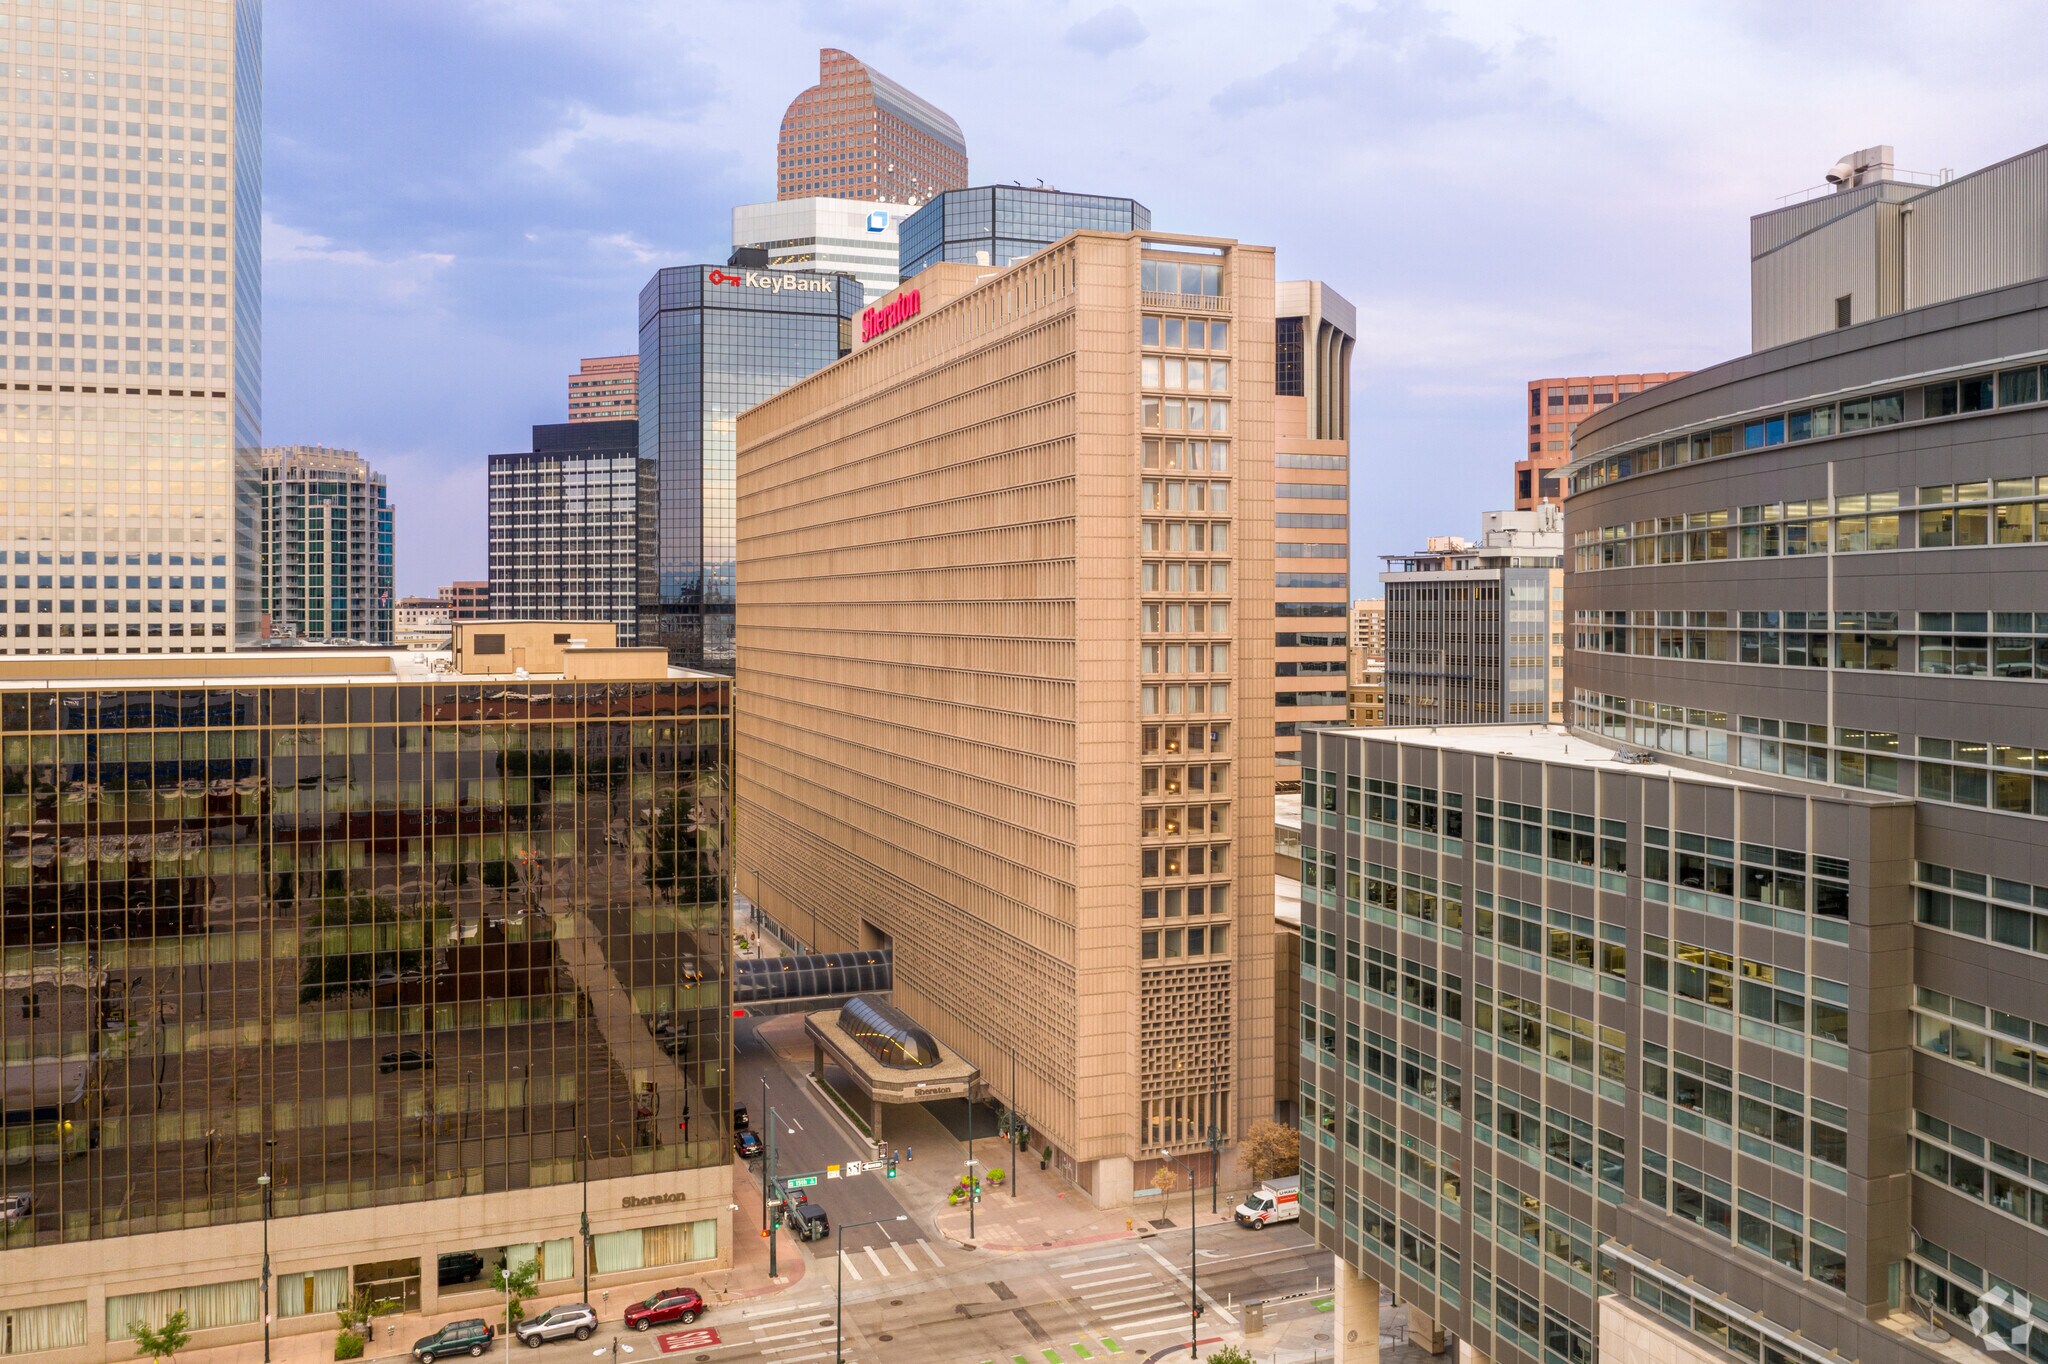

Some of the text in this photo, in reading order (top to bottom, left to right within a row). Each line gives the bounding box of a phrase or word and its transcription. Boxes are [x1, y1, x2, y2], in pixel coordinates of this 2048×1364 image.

[745, 271, 833, 294] KeyBank
[862, 288, 920, 343] Sheraton
[914, 1086, 951, 1097] Sheraton
[621, 1192, 686, 1209] Sheraton
